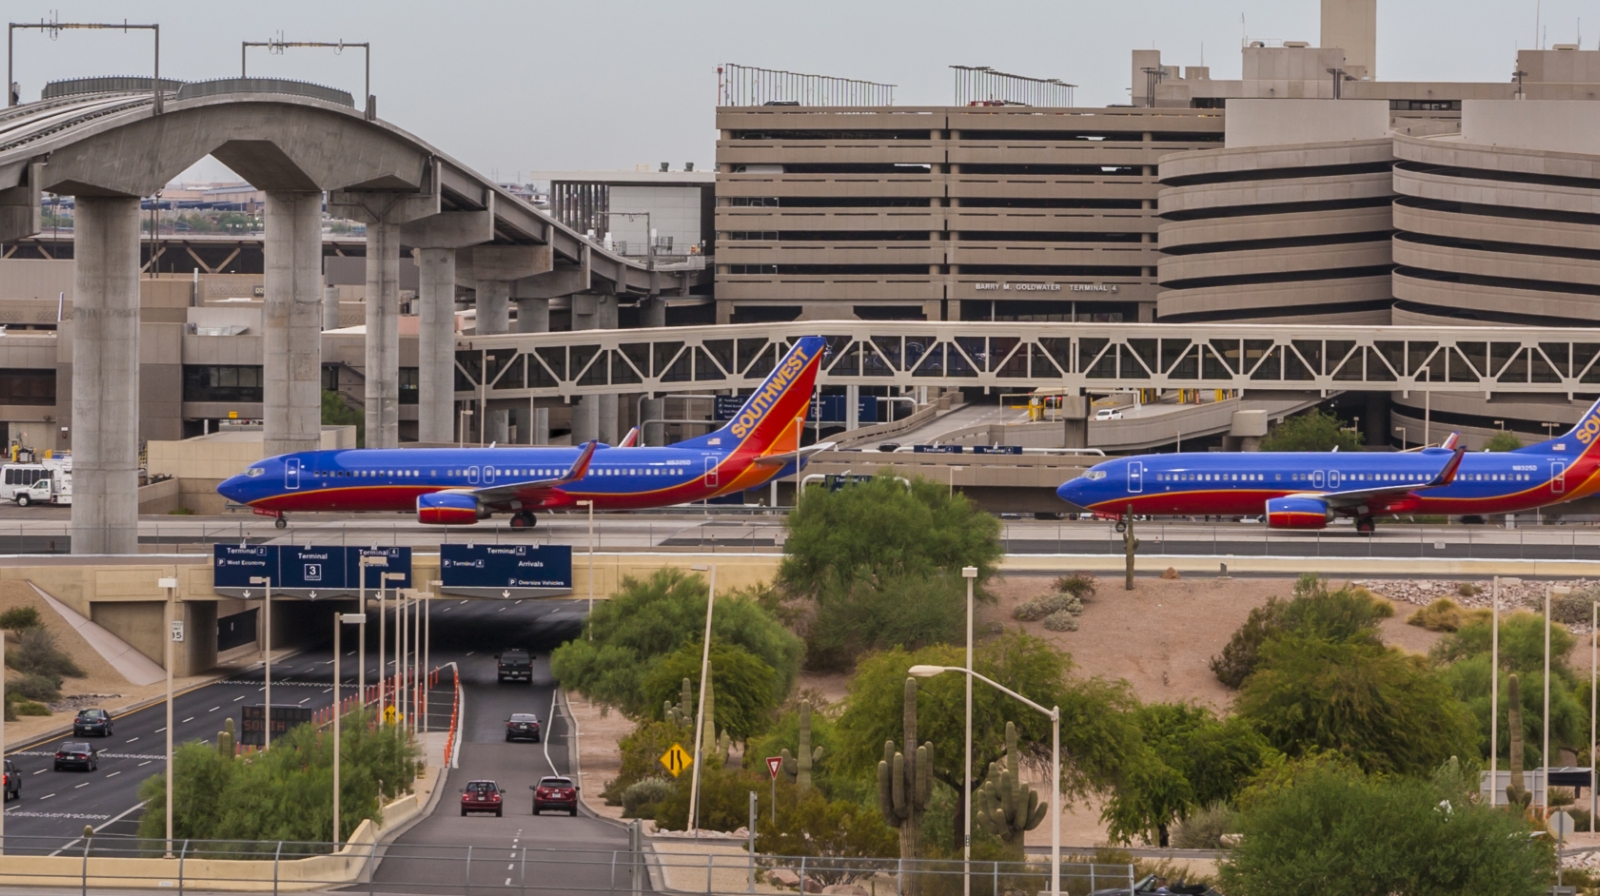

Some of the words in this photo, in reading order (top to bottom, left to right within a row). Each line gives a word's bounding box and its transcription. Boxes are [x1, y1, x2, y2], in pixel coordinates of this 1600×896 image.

[731, 346, 808, 438] SOUTHWEST
[309, 566, 316, 575] 3
[243, 720, 286, 732] SOUTH
